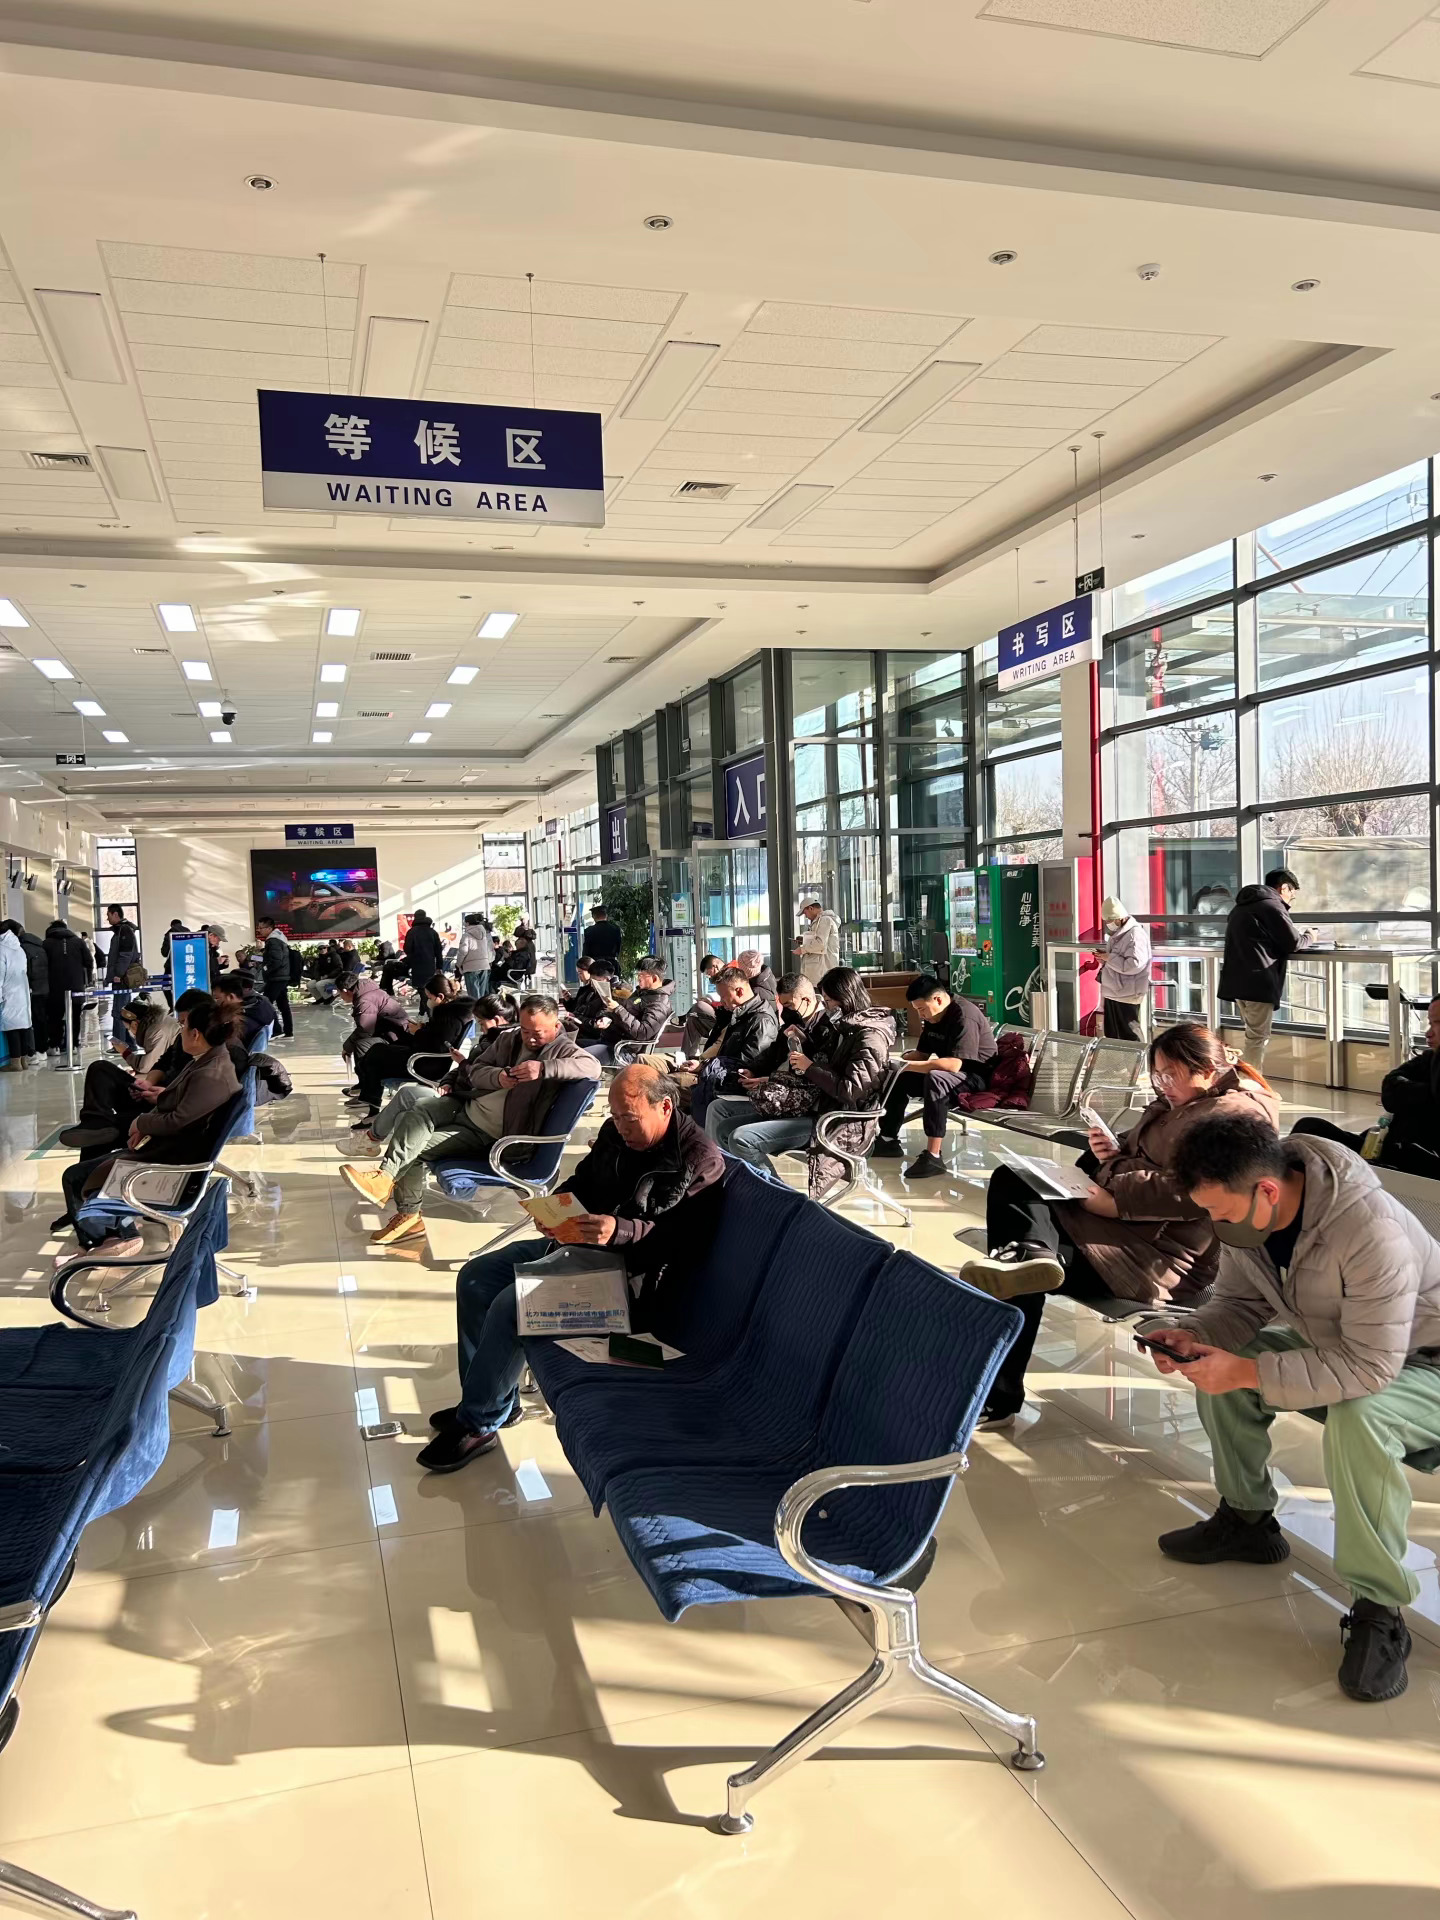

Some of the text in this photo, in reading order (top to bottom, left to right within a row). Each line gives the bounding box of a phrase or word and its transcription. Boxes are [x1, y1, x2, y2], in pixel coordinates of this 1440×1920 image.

[323, 413, 547, 471] 等候区
[326, 482, 549, 513] WAITING AREA
[1012, 610, 1076, 658] 书写区
[1012, 650, 1076, 681] WRITING AREA
[297, 827, 343, 837] 等候区
[611, 816, 628, 855] 出
[1019, 890, 1032, 927] 心纯净
[185, 943, 196, 990] 自助服务
